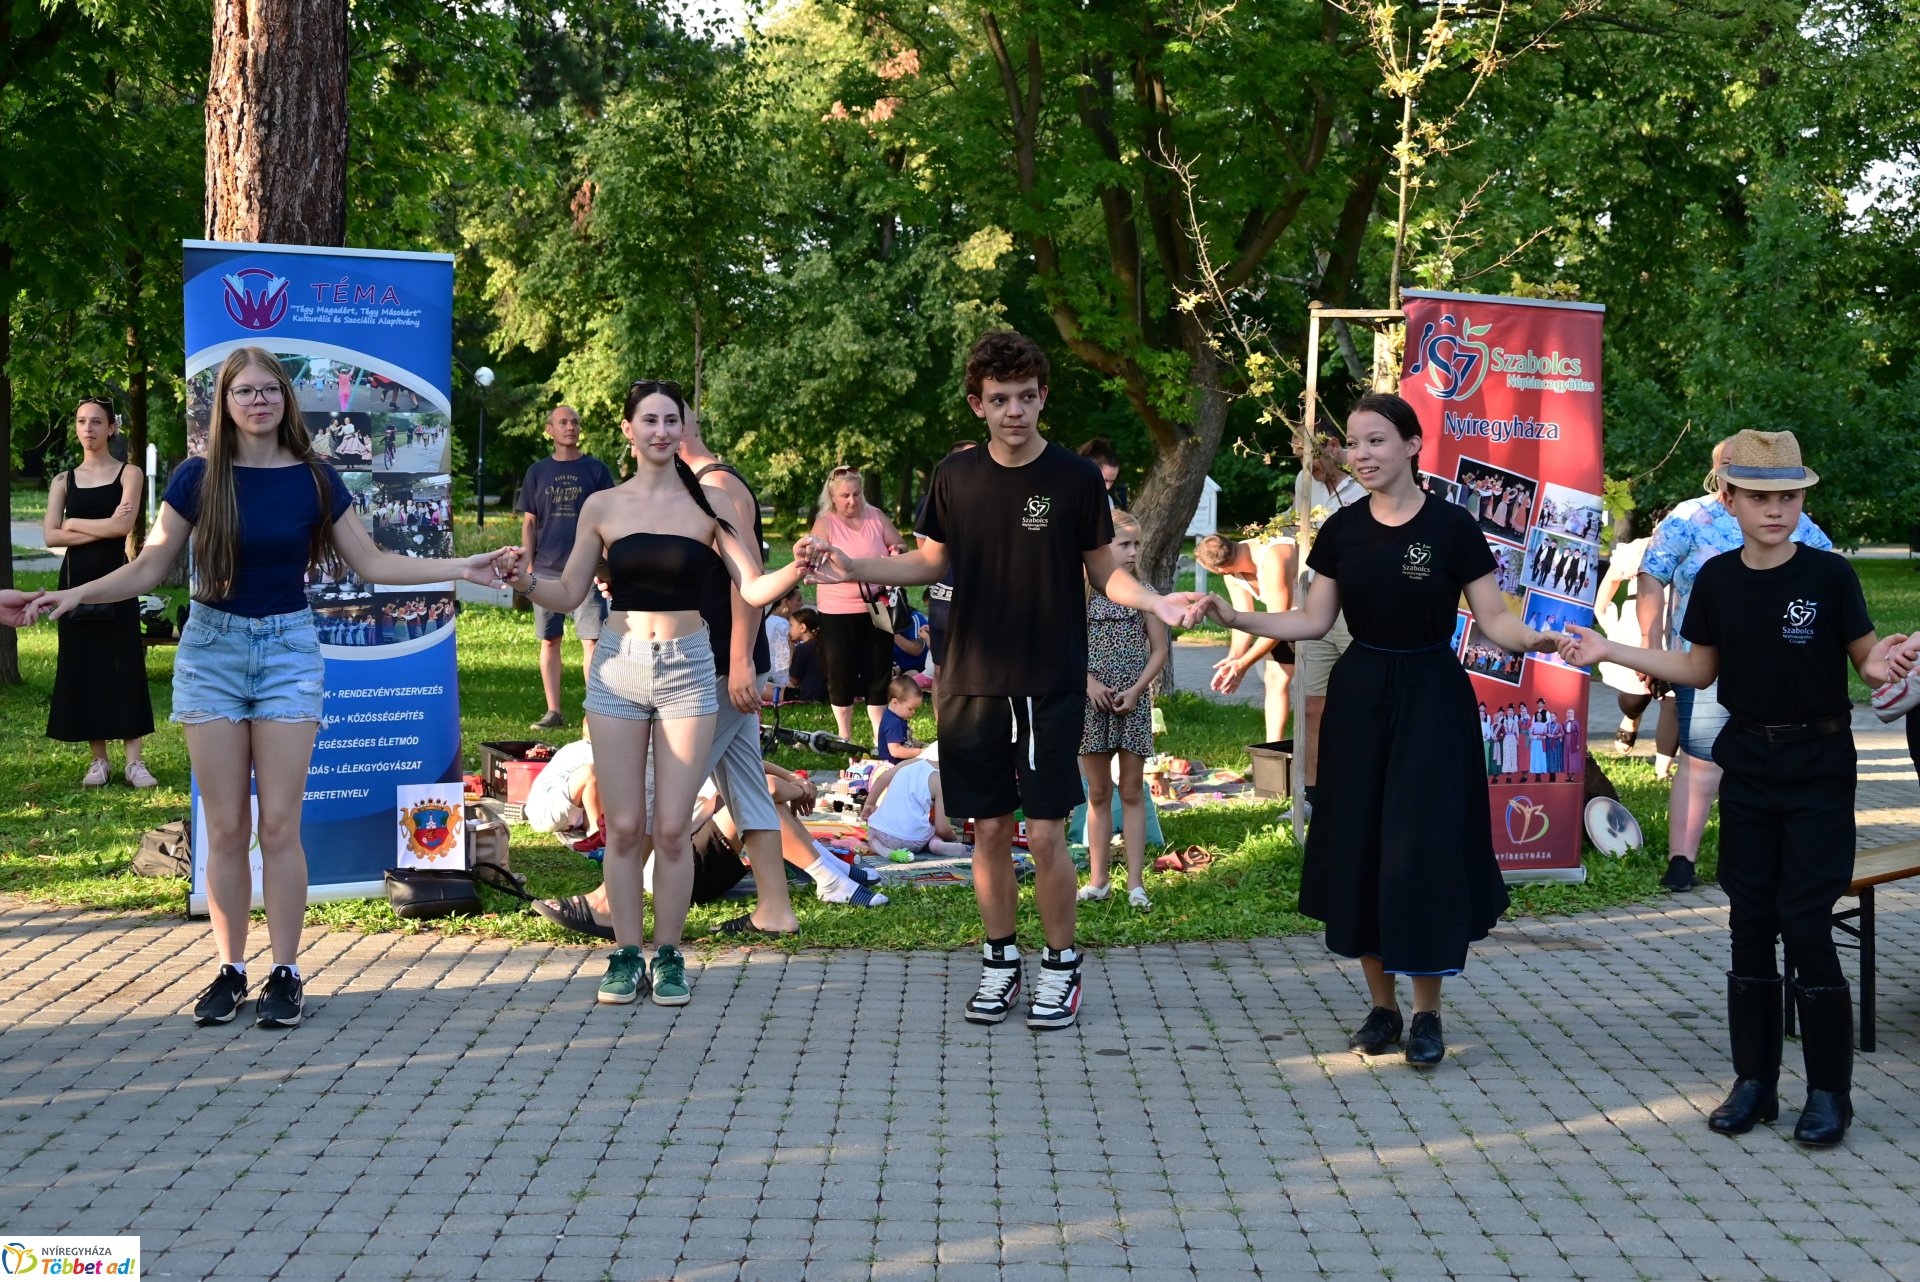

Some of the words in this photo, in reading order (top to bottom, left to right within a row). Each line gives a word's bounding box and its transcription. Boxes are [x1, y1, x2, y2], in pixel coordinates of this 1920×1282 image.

[310, 276, 400, 306] TÉMA
[292, 315, 331, 323] Kulturális
[333, 315, 342, 323] és
[344, 316, 376, 325] Szociális
[378, 317, 420, 328] Alapítvány
[1491, 347, 1582, 375] Szabolcs
[1507, 373, 1596, 394] Néptáncegyüttes
[1444, 411, 1560, 443] Nyíregyháza
[1402, 564, 1430, 572] Szabolcs
[1782, 626, 1814, 635] Szabolcs
[338, 684, 444, 699] RENDEZVÉNYSZERVEZÉS
[347, 710, 425, 723] KÖZÖSSÉGÉPÍTÉS
[318, 737, 376, 750] EGÉSZSÉGES
[378, 735, 419, 747] ÉLETMÓD
[337, 760, 423, 774] LÉLEKGYÓGYÁSZAT
